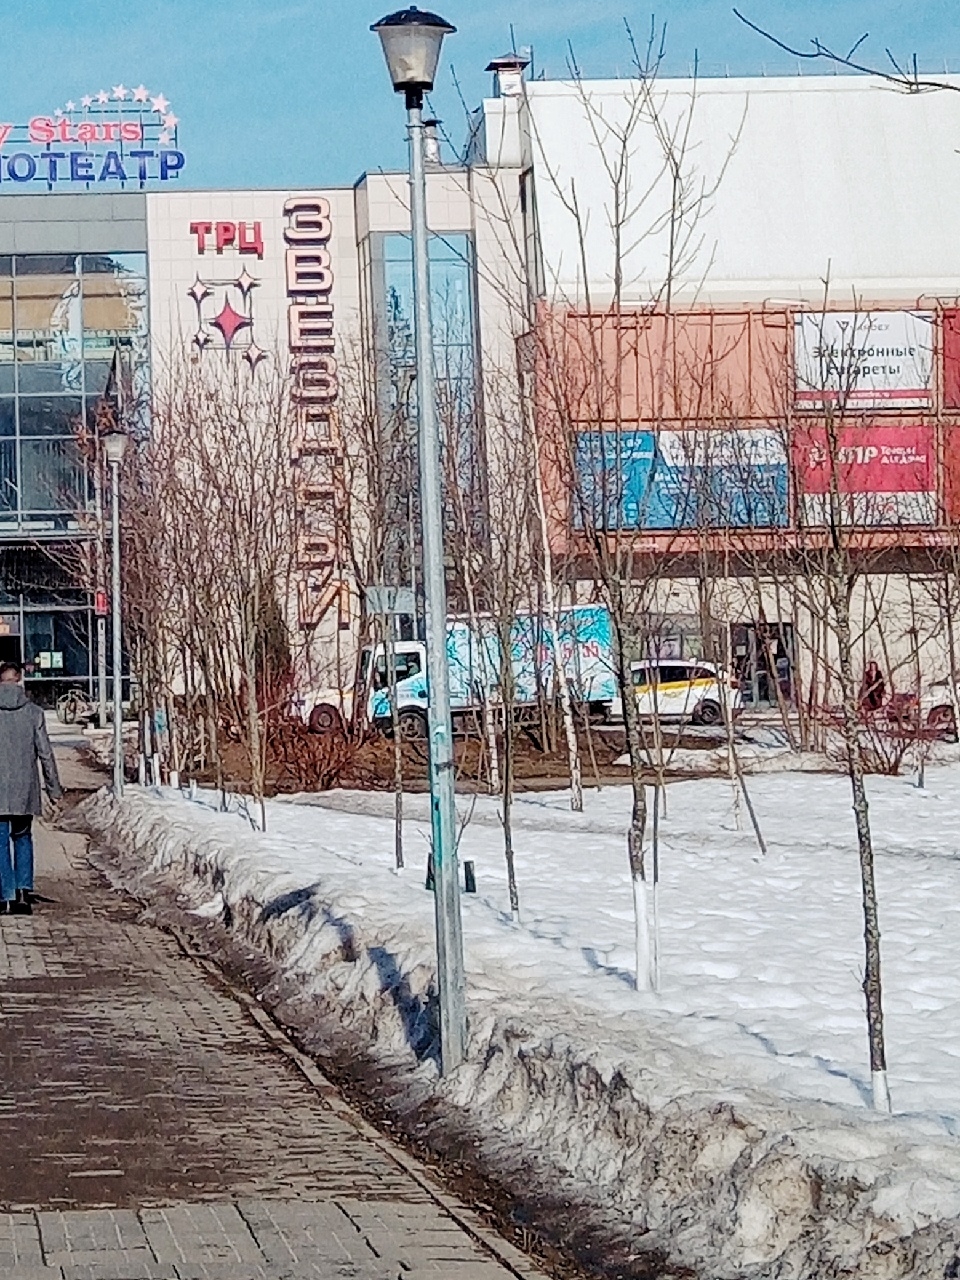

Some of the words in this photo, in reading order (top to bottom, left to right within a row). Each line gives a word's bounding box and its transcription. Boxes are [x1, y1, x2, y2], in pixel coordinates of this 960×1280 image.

[29, 116, 143, 143] Stars
[190, 221, 264, 260] ТРЦ
[813, 345, 916, 360] Эеронные
[826, 364, 901, 378] ареты
